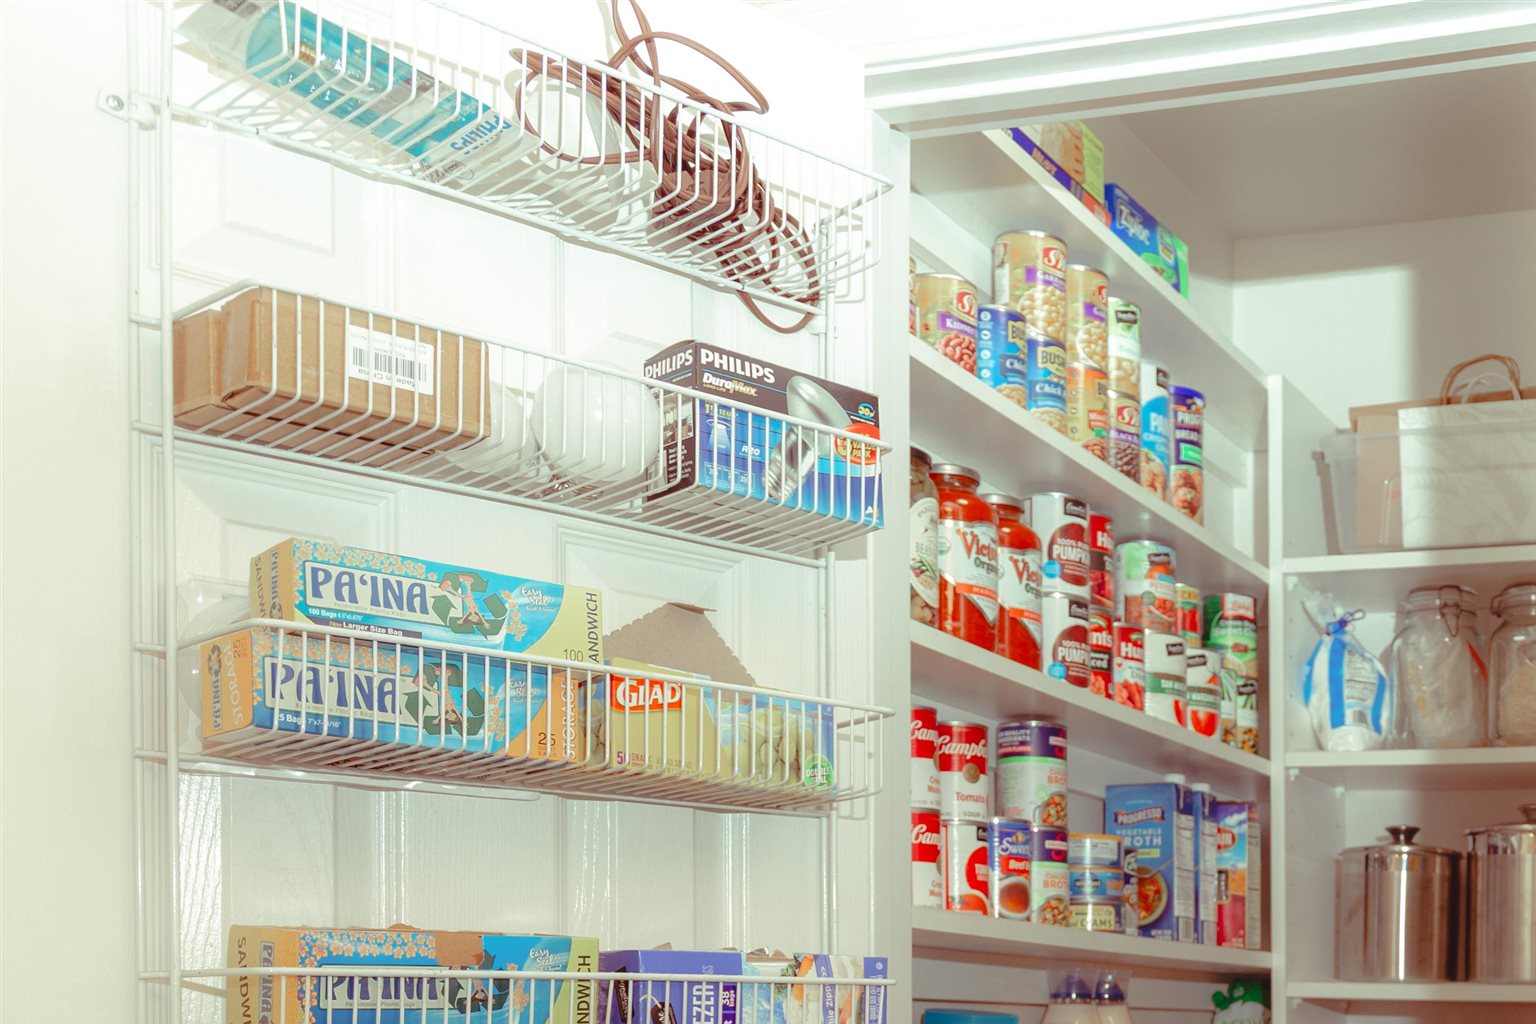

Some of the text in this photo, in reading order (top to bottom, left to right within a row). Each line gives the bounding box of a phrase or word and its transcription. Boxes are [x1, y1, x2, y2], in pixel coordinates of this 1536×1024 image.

[644, 348, 693, 380] PHILIPS
[700, 347, 776, 385] PHILIPS
[310, 566, 430, 615] PA'INA
[321, 609, 337, 619] Bags
[343, 621, 368, 630] Larger
[370, 625, 386, 634] Size
[388, 628, 403, 636] Bag
[586, 591, 600, 664] ANDWICH
[563, 648, 584, 663] 100
[223, 638, 244, 725] STORAGE
[616, 680, 681, 708] GLAD
[286, 714, 306, 725] Bag
[561, 679, 577, 760] STORAGE
[538, 732, 556, 746] 25
[1123, 836, 1162, 847] ROTH
[721, 991, 730, 1006] 38
